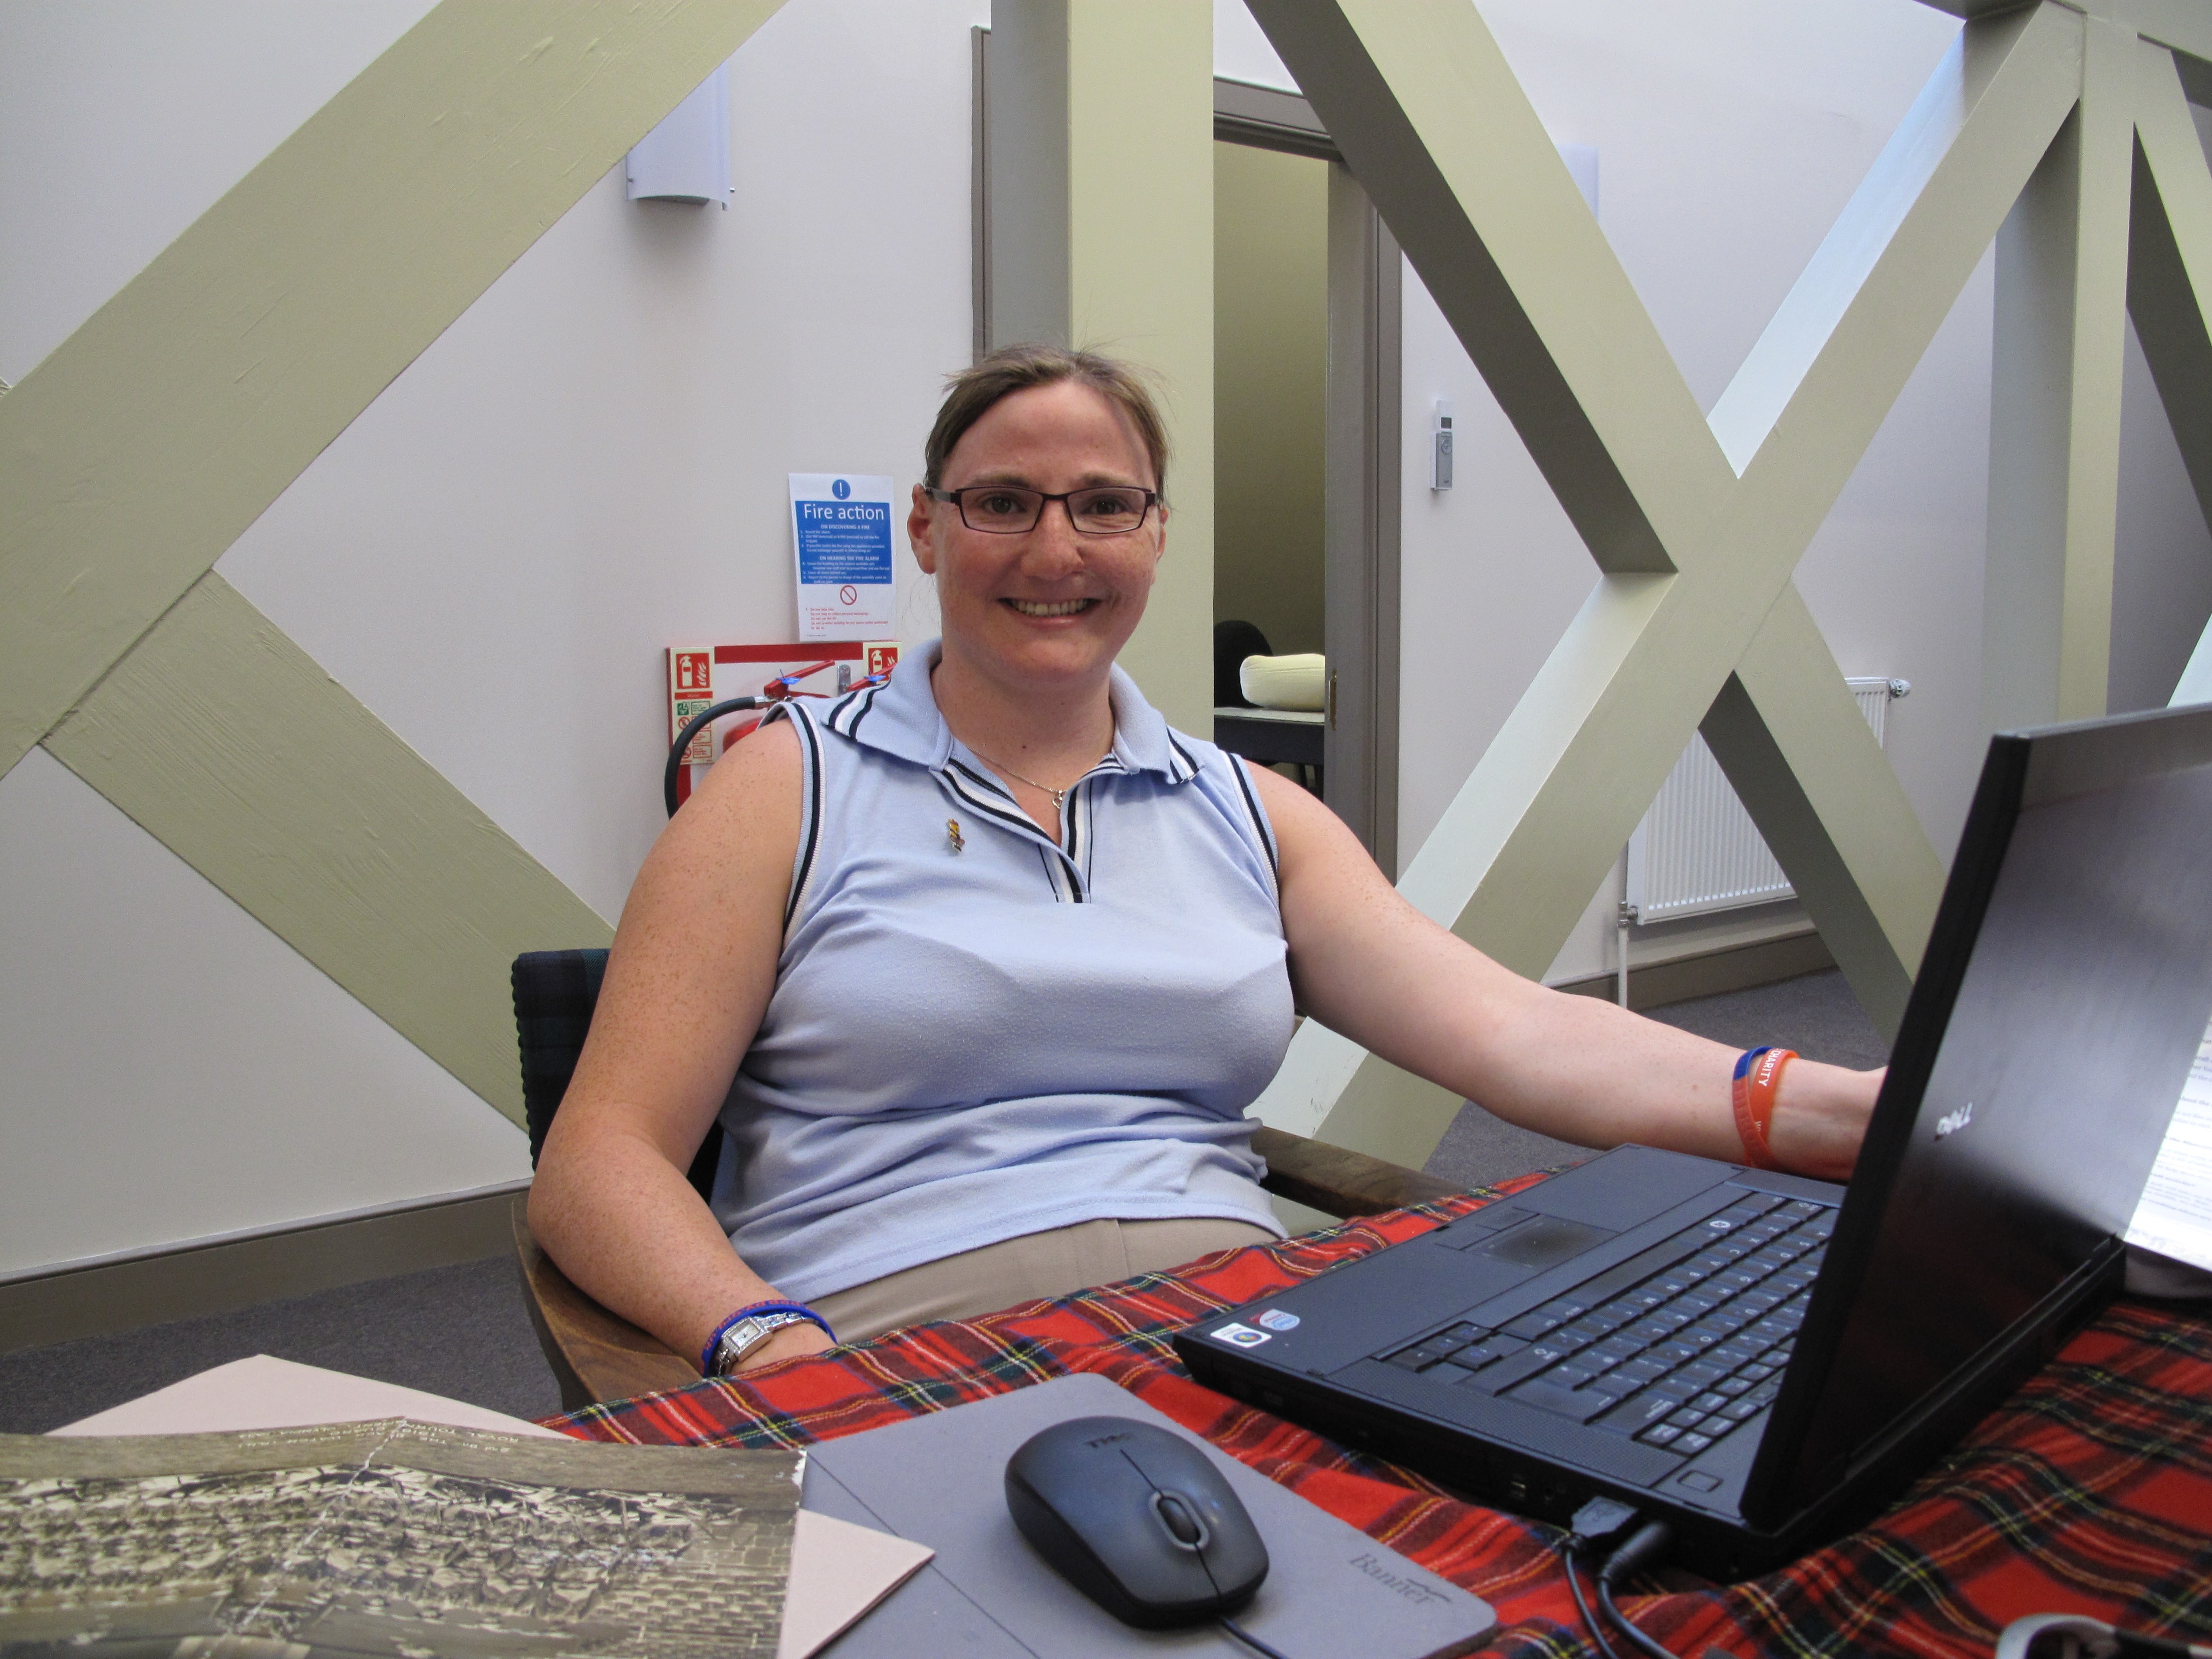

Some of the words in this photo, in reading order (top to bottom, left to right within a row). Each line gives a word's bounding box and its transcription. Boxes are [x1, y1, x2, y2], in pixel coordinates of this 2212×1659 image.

[804, 503, 833, 519] Fire
[838, 504, 884, 520] action
[1758, 1049, 1782, 1086] CHARITY
[1349, 1553, 1435, 1604] Banner
